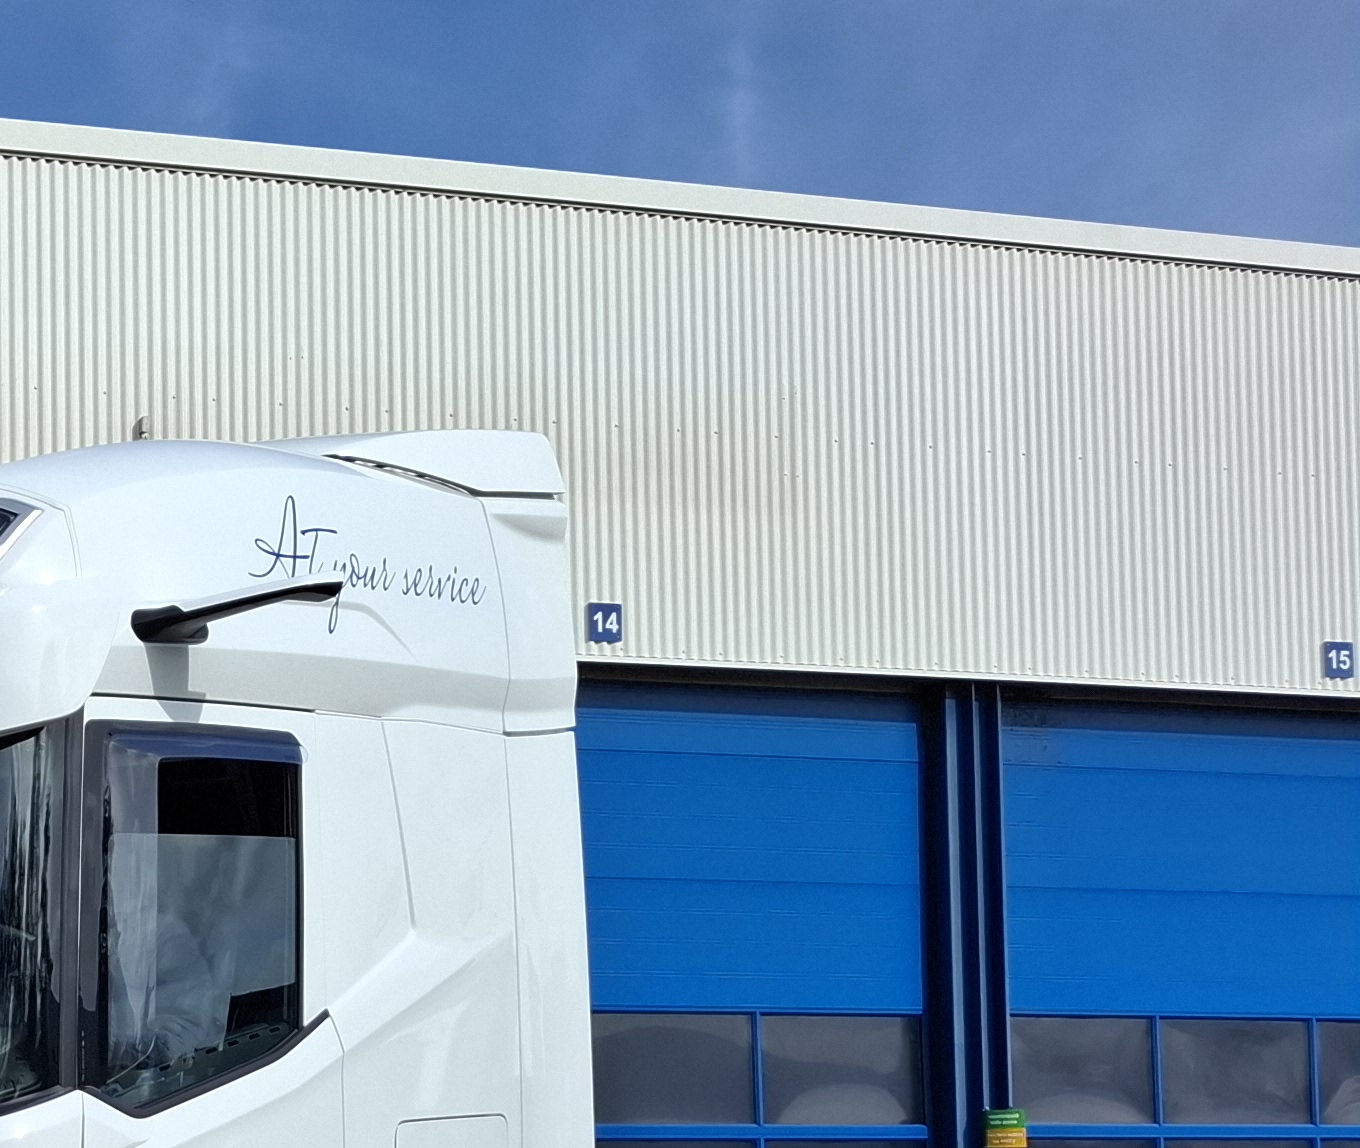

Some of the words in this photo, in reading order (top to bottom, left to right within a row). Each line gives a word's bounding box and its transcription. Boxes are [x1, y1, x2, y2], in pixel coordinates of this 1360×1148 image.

[401, 565, 487, 605] service
[593, 611, 620, 634] 14
[1328, 649, 1351, 670] 15
